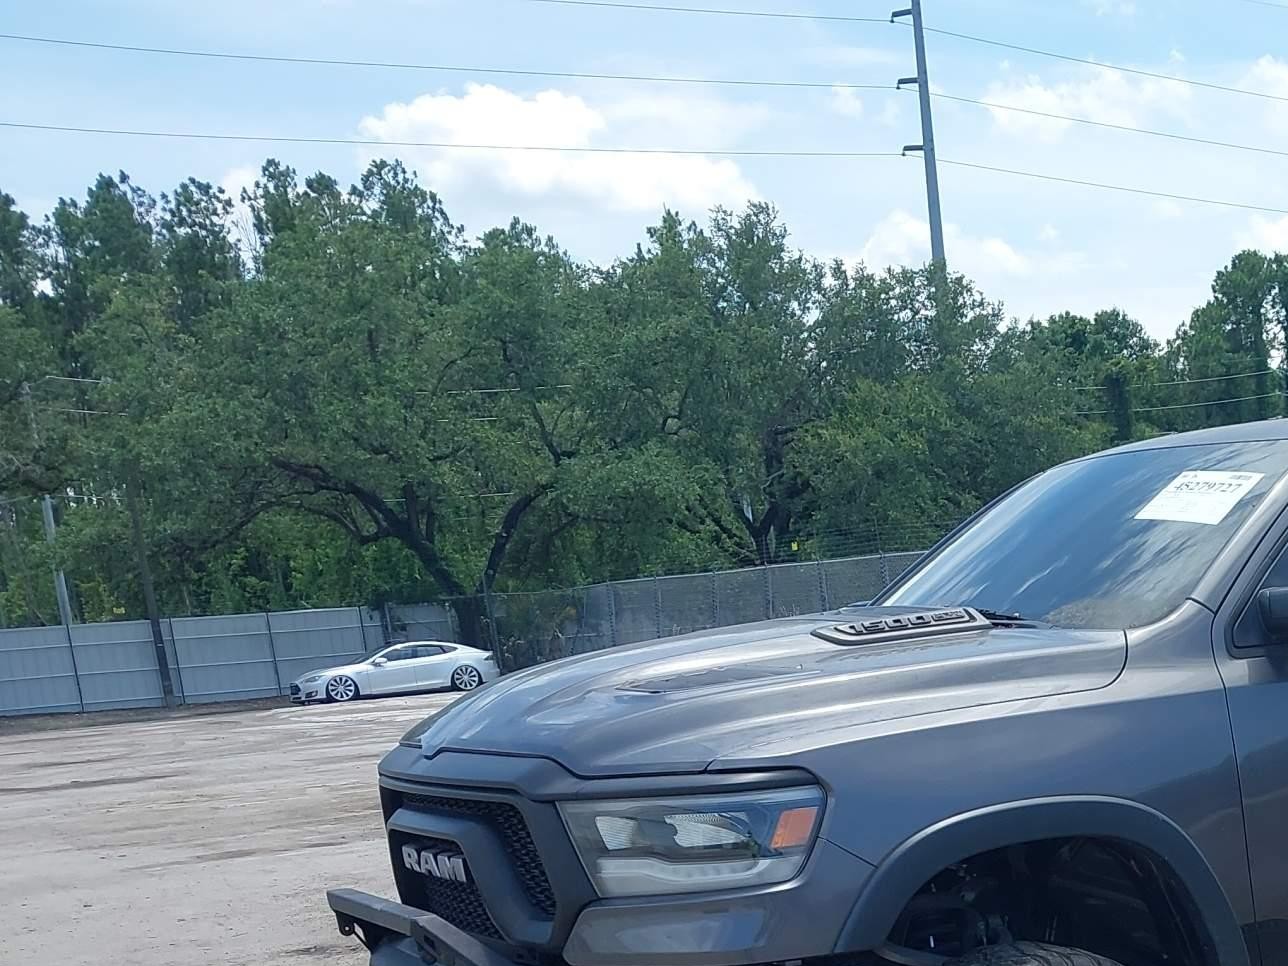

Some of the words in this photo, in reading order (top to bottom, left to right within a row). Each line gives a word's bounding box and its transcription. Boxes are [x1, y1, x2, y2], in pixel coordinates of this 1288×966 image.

[1173, 481, 1243, 494] 45279727
[847, 614, 932, 634] 1500
[401, 845, 467, 883] RAM
